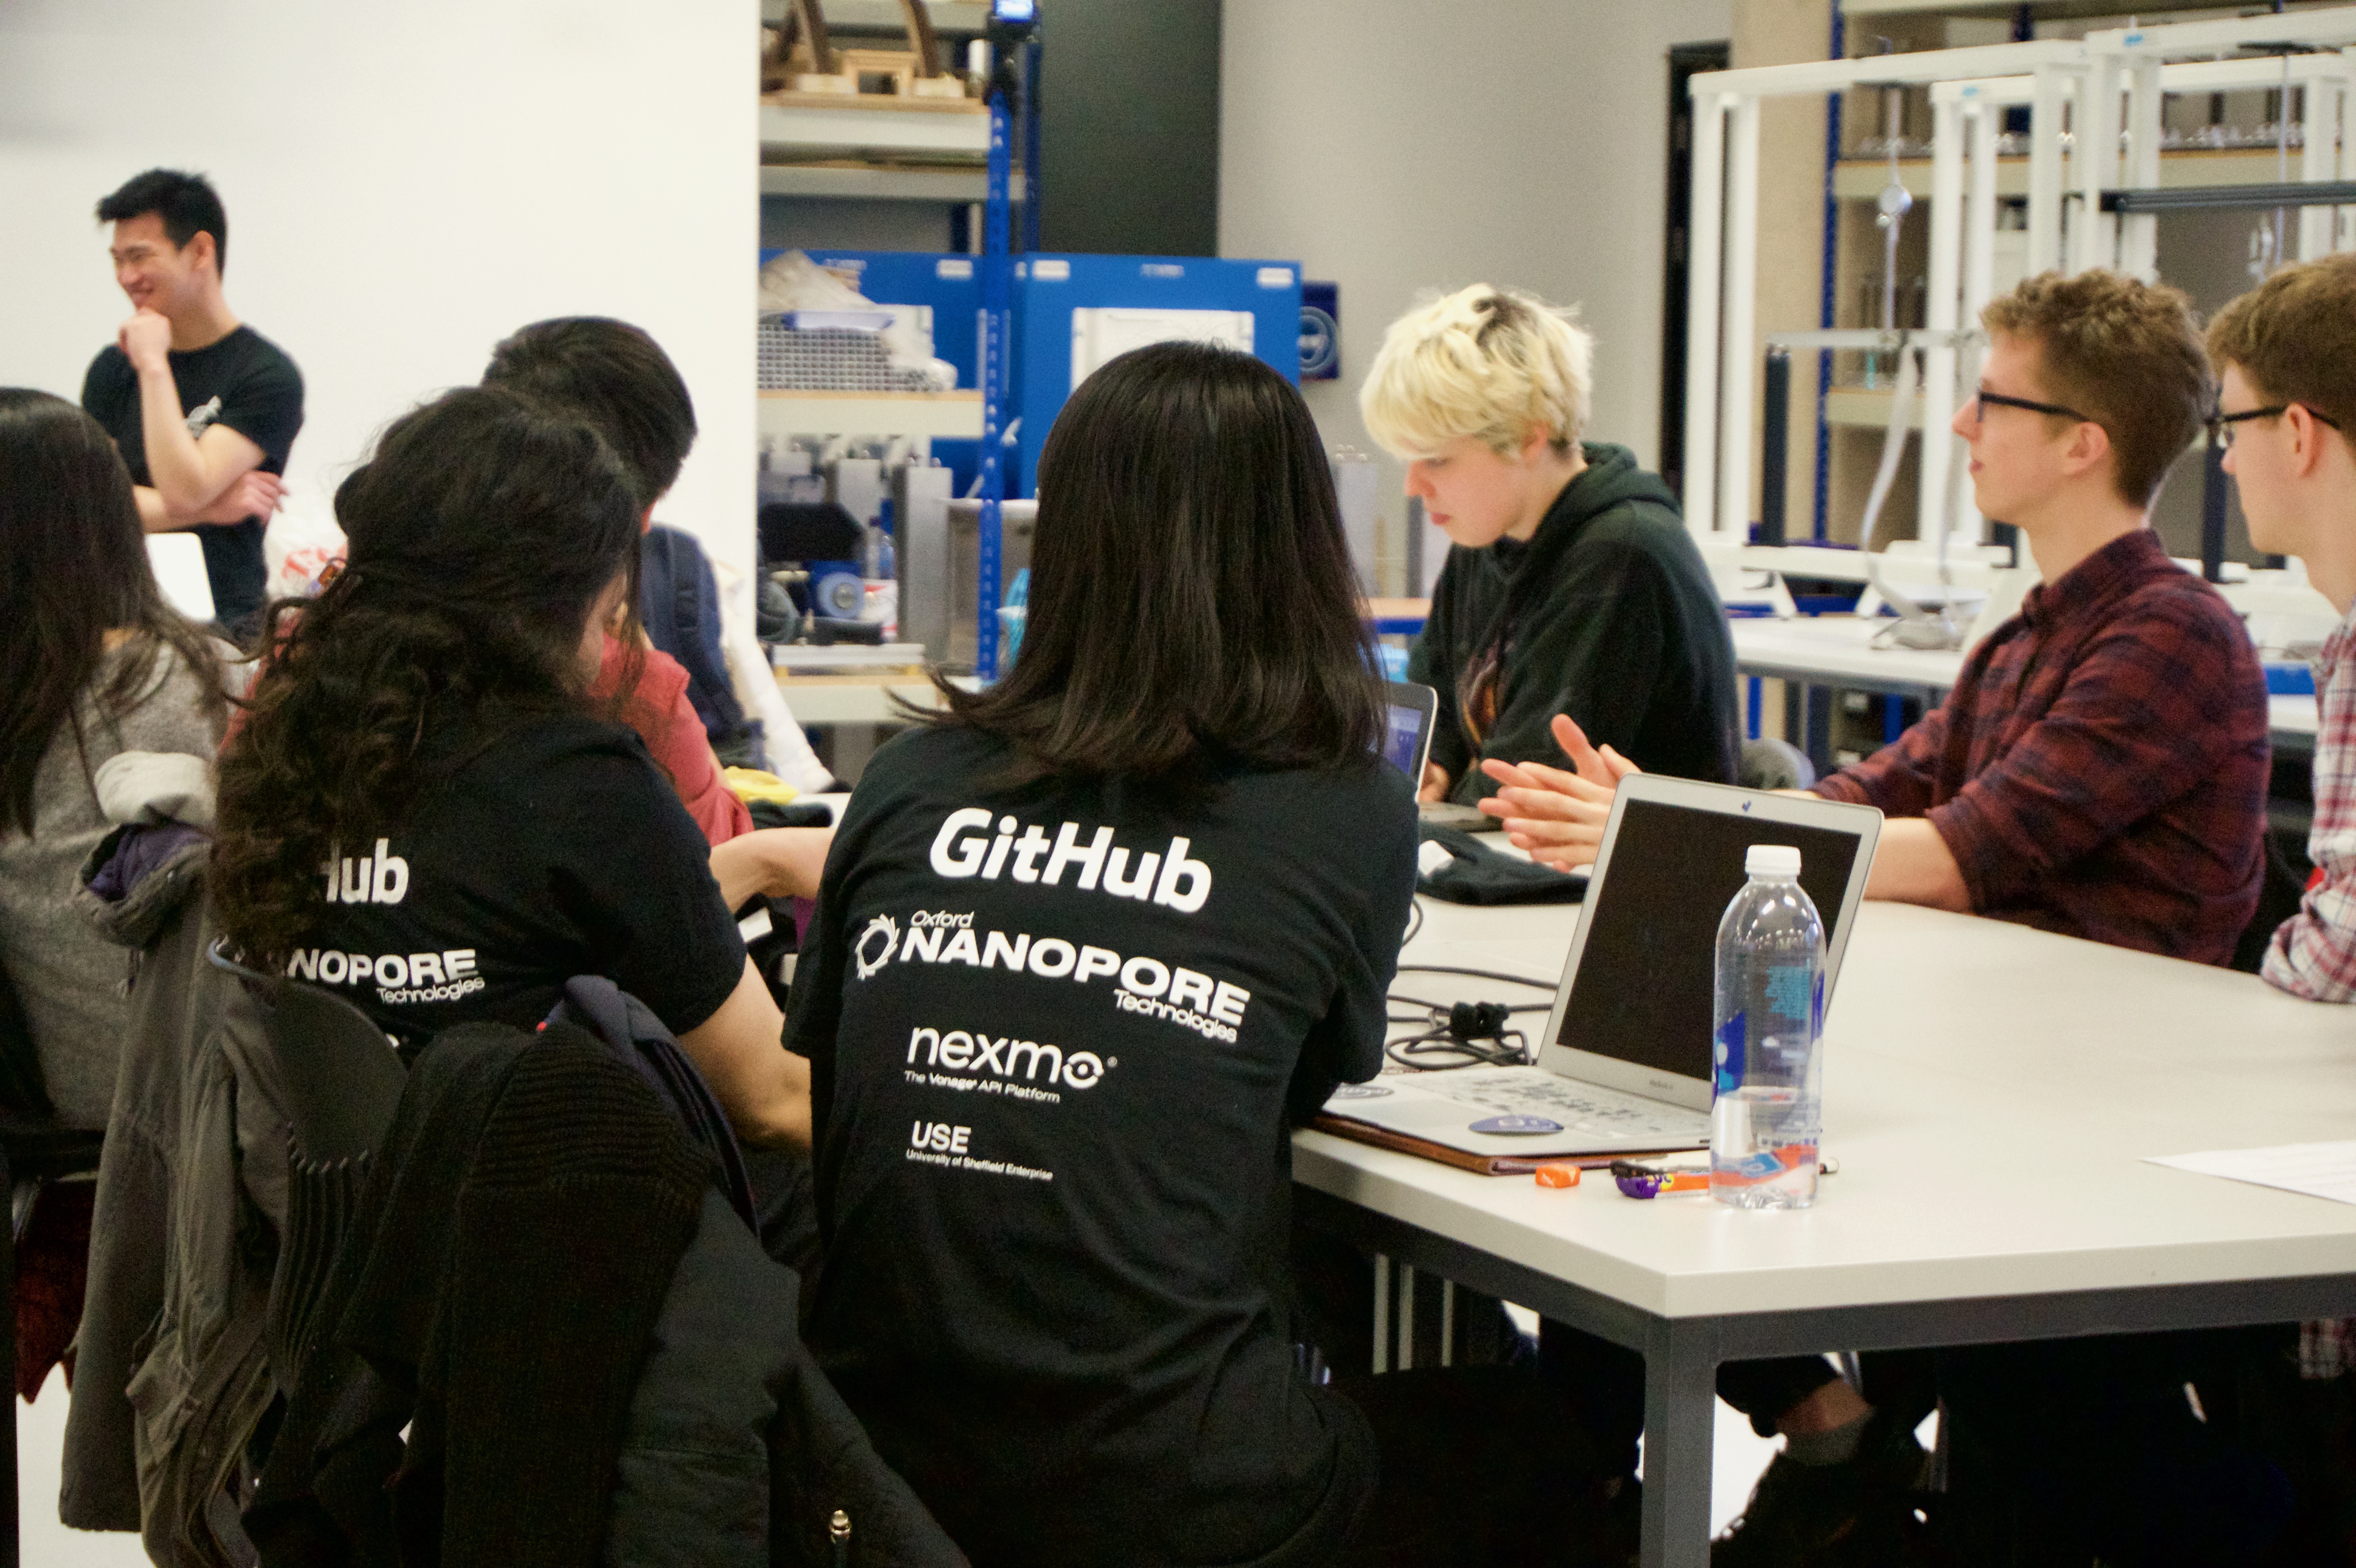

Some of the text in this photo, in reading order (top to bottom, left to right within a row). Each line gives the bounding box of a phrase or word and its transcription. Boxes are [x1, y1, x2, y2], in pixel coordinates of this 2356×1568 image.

[930, 808, 1212, 913] GitHub
[910, 910, 974, 928] Oxford
[288, 948, 478, 987] NOPORE
[900, 926, 1251, 1025] NANOPORE
[377, 977, 484, 1003] Technologies
[1113, 989, 1237, 1043] Technologies
[907, 1027, 1104, 1089] nexmo
[905, 1070, 926, 1084] The
[978, 1080, 1002, 1093] API
[1005, 1084, 1060, 1103] Platform
[912, 1121, 971, 1154] USE
[906, 1149, 1053, 1180] University of Sheffield Enterprise
